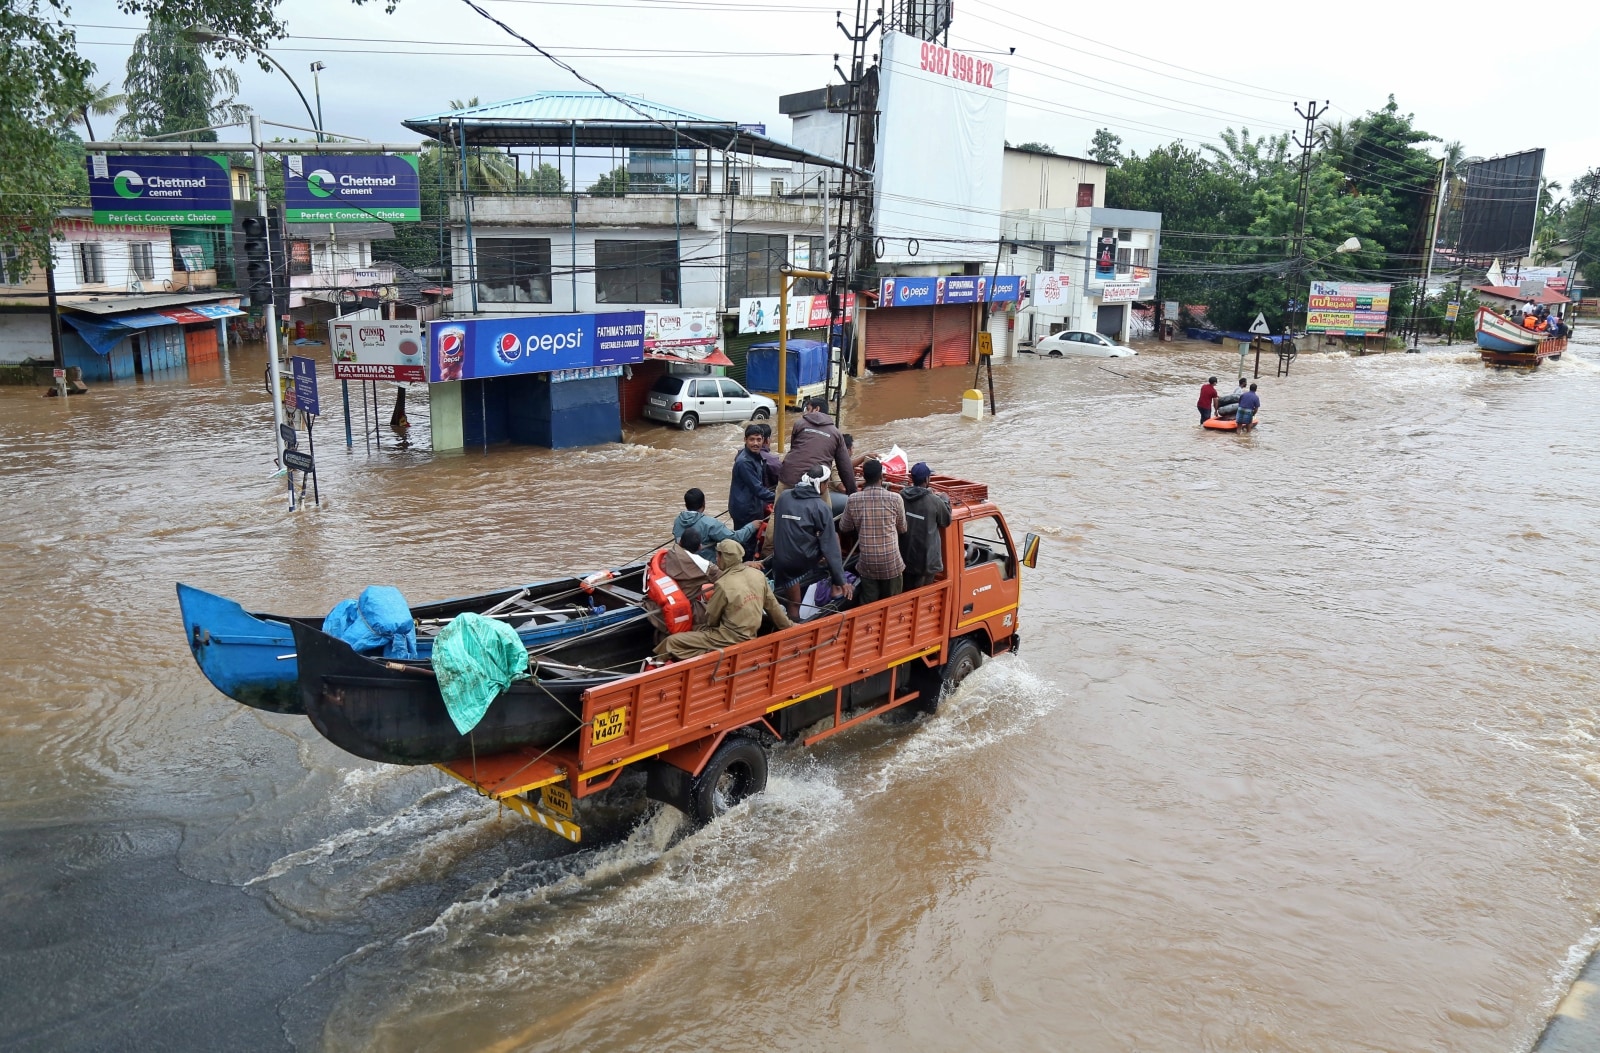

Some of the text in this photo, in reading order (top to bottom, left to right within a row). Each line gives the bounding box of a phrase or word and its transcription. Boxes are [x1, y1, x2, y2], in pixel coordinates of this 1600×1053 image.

[921, 42, 993, 89] 9387 998 812
[147, 176, 206, 188] Chettinad
[339, 175, 396, 186] Chettinad
[148, 189, 183, 197] cement
[340, 187, 373, 195] cement
[108, 213, 217, 222] Perfect Concrete Choice
[301, 211, 405, 219] Perfect Concrete Choice
[910, 285, 930, 298] pepsi
[997, 283, 1013, 293] pepsi
[1317, 287, 1338, 296] tech
[773, 303, 791, 316] AT
[359, 327, 386, 342] CHINNAR
[597, 324, 643, 338] FATHIMA'S FRUITS
[526, 328, 584, 357] pepsi
[600, 340, 621, 350] VEGETABLES
[981, 341, 990, 351] 47
[337, 365, 395, 374] FATHIMA'S
[610, 714, 620, 724] 07
